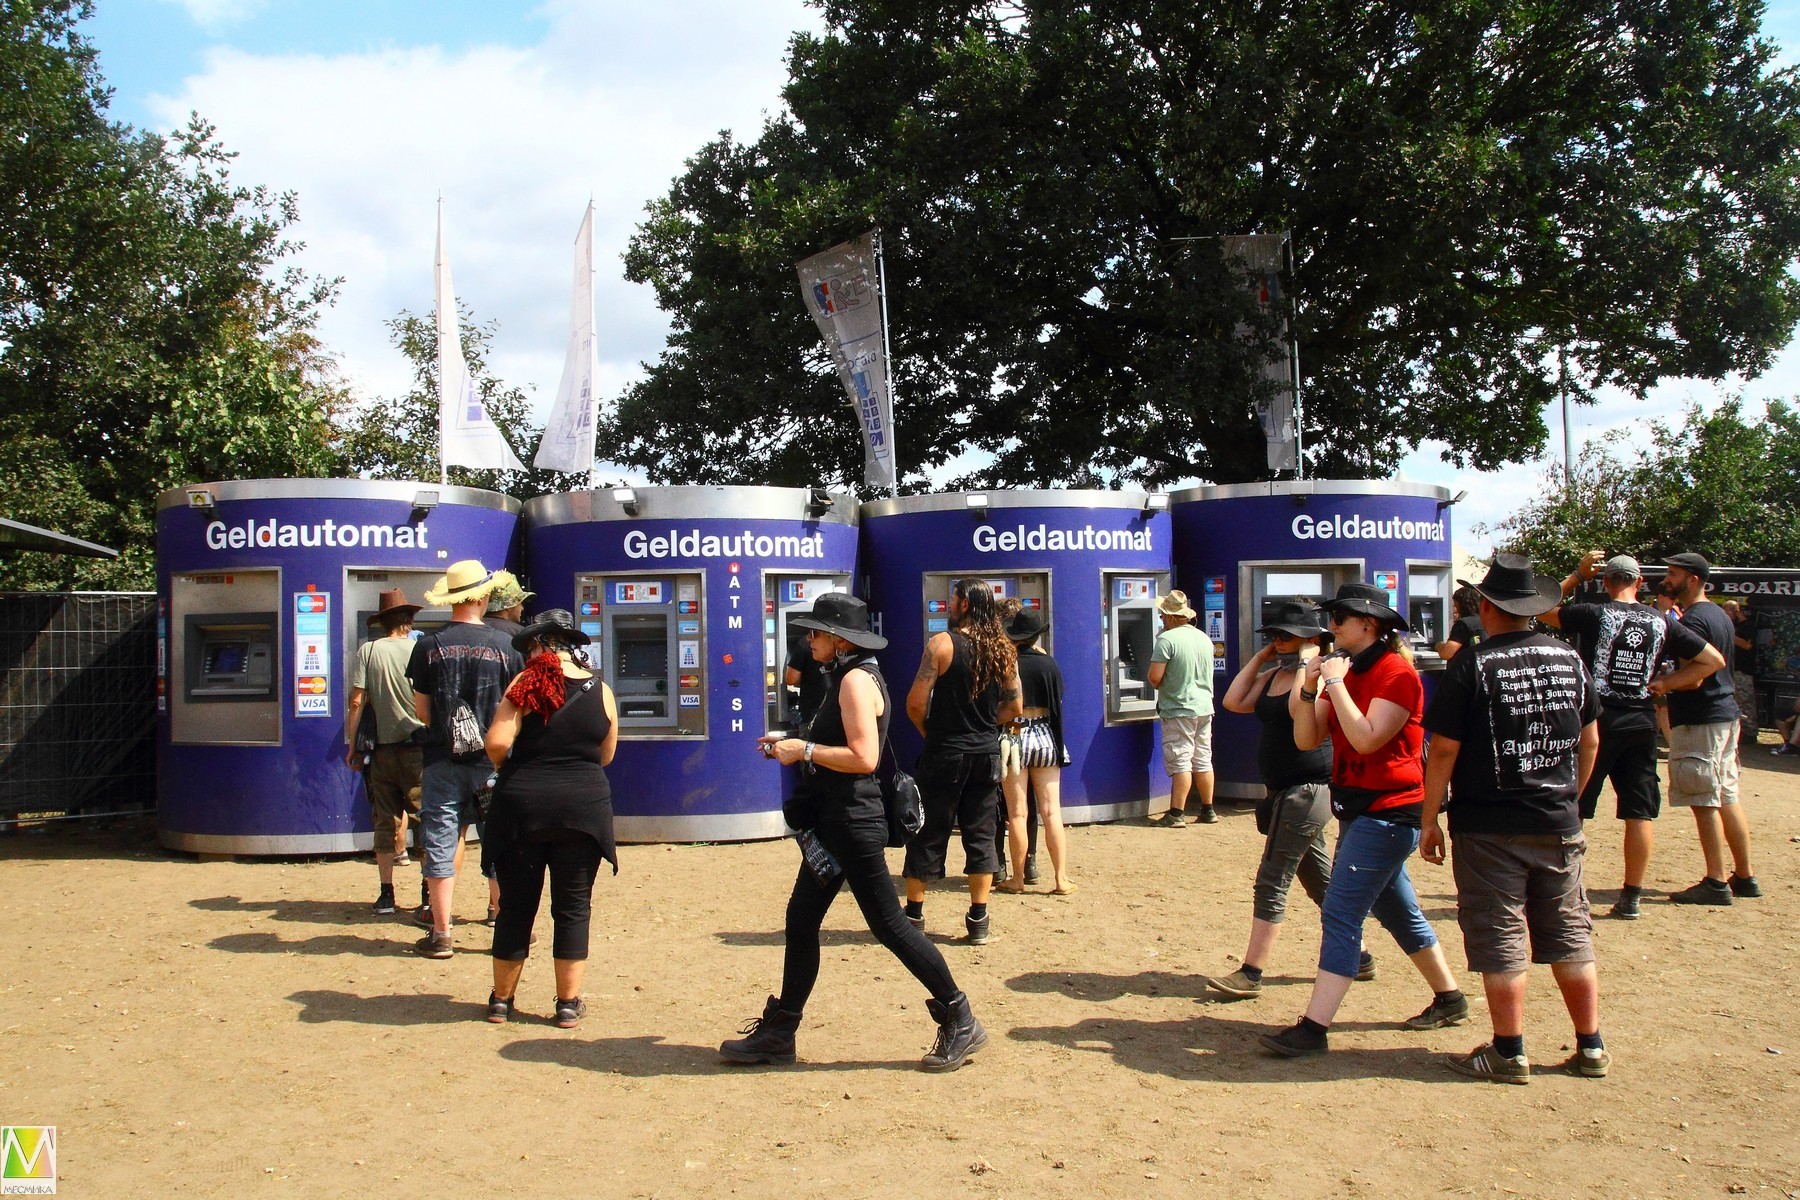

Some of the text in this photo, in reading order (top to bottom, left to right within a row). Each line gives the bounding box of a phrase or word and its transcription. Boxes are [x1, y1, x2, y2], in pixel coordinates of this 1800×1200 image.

[206, 518, 428, 550] Geldautomat
[1291, 514, 1444, 542] Geldautomat
[623, 530, 824, 558] Geldautomat
[973, 524, 1152, 552] Geldautomat
[1617, 650, 1645, 659] WILL TO
[1214, 660, 1224, 668] ISA
[1497, 663, 1573, 679] Neglecting Existence
[1615, 661, 1642, 670] WACKEN
[1533, 678, 1548, 687] And
[1551, 676, 1576, 686] Repent
[302, 699, 326, 708] VISA
[1501, 694, 1515, 703] An
[1545, 689, 1576, 700] Journey
[1528, 704, 1543, 713] The
[1528, 721, 1552, 738] My
[1517, 757, 1532, 773] Is
